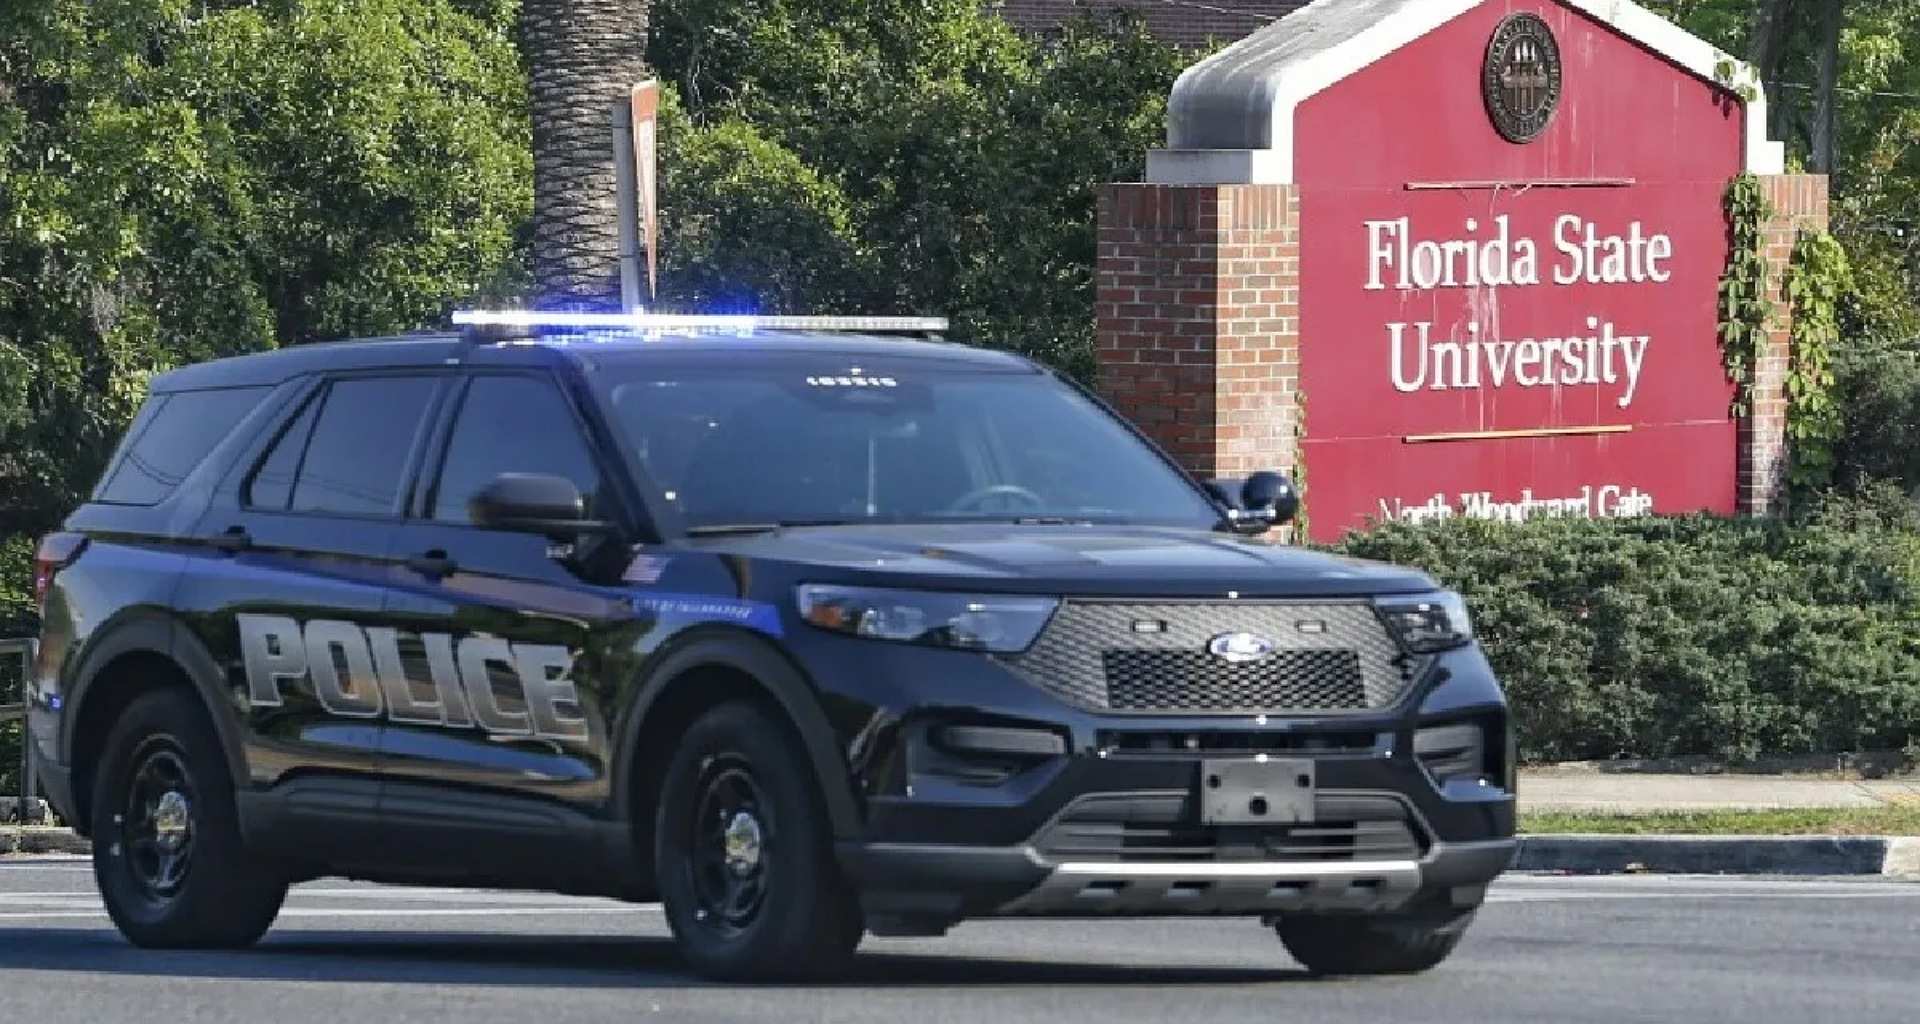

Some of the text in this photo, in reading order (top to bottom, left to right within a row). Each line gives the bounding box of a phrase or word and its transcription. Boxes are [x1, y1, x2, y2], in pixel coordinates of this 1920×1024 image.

[1363, 214, 1672, 290] Florida State
[1385, 316, 1651, 409] University
[1598, 484, 1653, 518] Gate
[235, 613, 589, 742] POLICE
